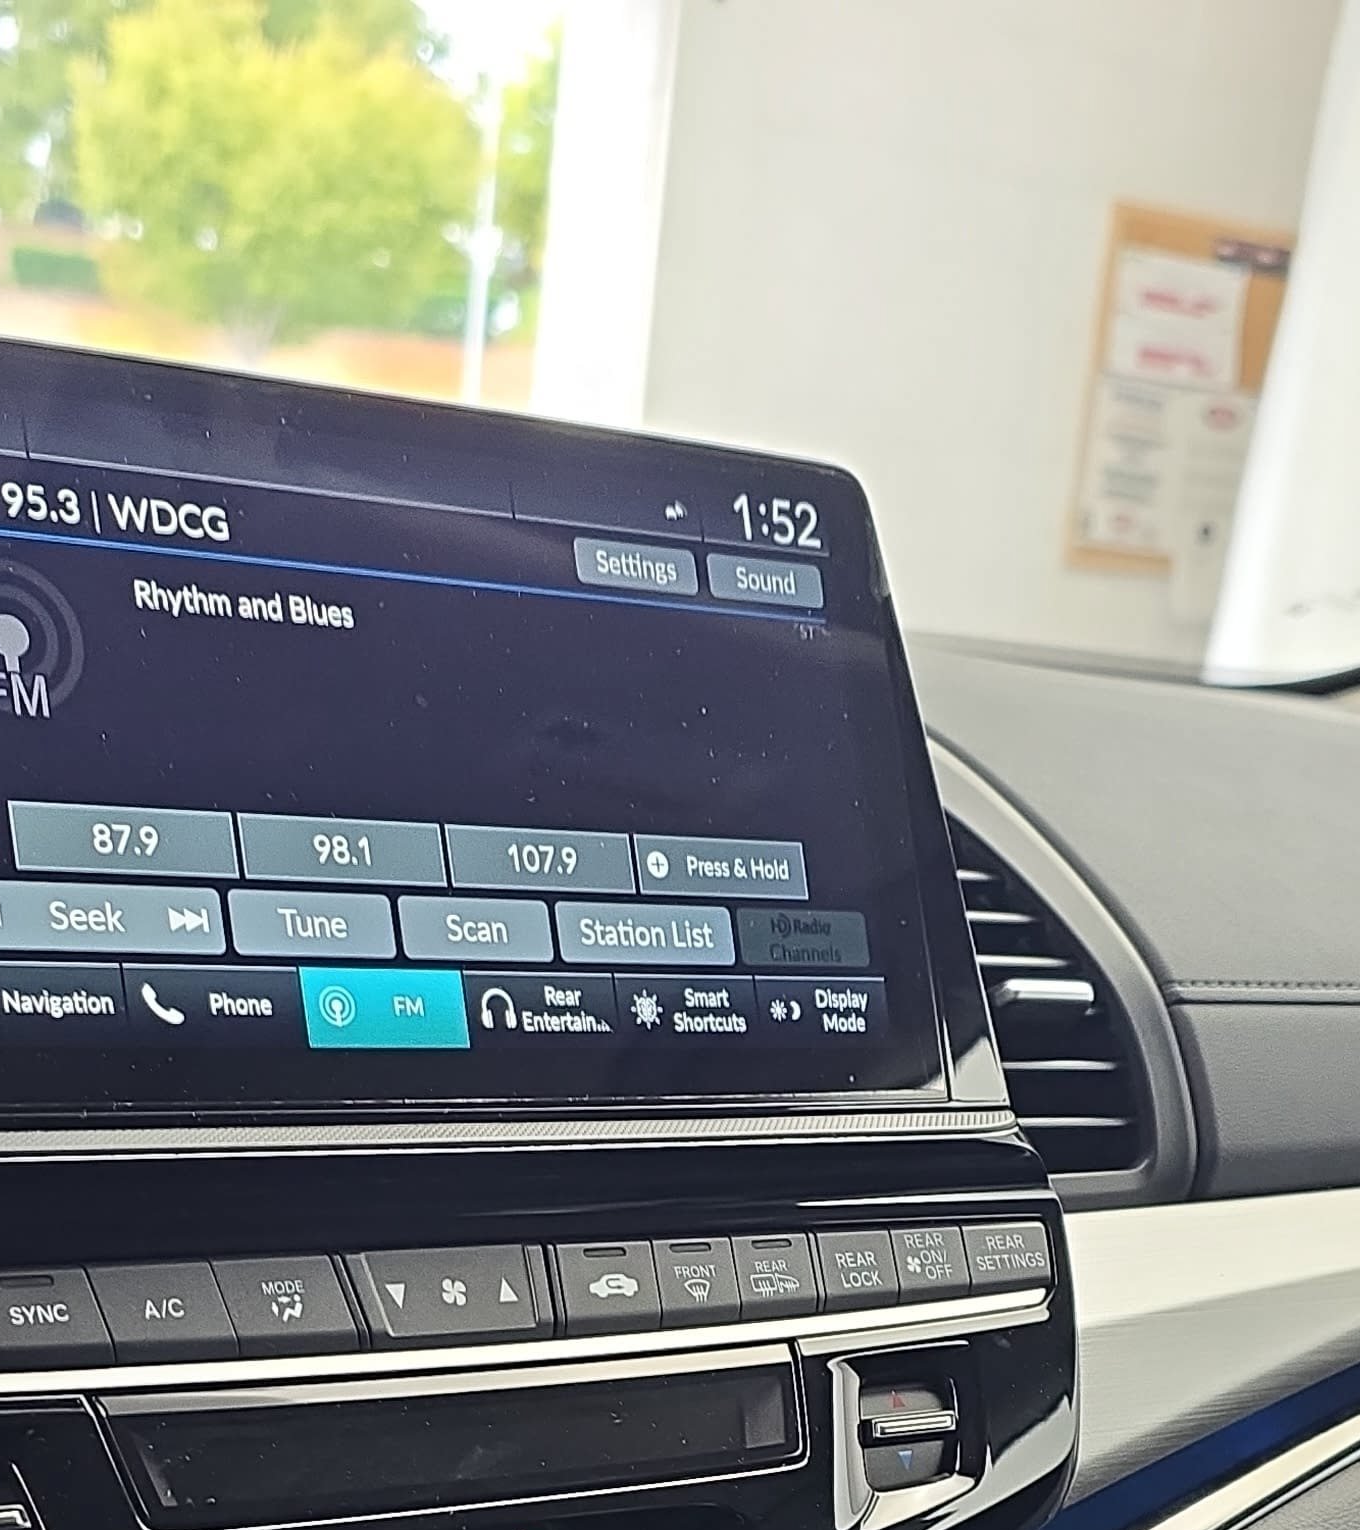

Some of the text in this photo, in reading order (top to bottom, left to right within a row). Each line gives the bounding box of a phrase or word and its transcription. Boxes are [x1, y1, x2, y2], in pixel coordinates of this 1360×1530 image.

[1, 481, 231, 543] 95.3 WDCG
[733, 493, 823, 550] 1:52
[596, 549, 677, 586] Settings
[736, 566, 797, 596] Sound
[133, 578, 355, 631] Rhythm and Blues
[92, 822, 160, 857] 87.9
[312, 833, 373, 867] 98.1
[506, 843, 578, 876] 107.9
[686, 854, 790, 882] Press & Hold
[48, 899, 127, 934] Seek
[277, 907, 348, 940] Tune
[446, 914, 509, 944] Scan
[580, 919, 714, 950] Station List
[1, 988, 116, 1020] Navigation
[209, 991, 273, 1017] Phone
[393, 995, 425, 1018] FM
[543, 984, 582, 1007] Rear
[684, 987, 730, 1009] Smart
[815, 988, 868, 1014] Display
[674, 1011, 747, 1034] Shortcuts
[823, 1011, 867, 1034] Mode
[904, 1232, 945, 1250] REAR
[986, 1234, 1025, 1252] REAR
[755, 1257, 788, 1274] REAR
[836, 1251, 878, 1269] REAR
[920, 1248, 948, 1265] ON/
[976, 1251, 1046, 1272] SETTINGS
[674, 1264, 717, 1280] FRONT
[841, 1269, 883, 1289] LOCK
[926, 1263, 954, 1282] OFF
[261, 1279, 305, 1297] MODE
[8, 1303, 70, 1327] SYNC
[145, 1298, 186, 1321] A/C
